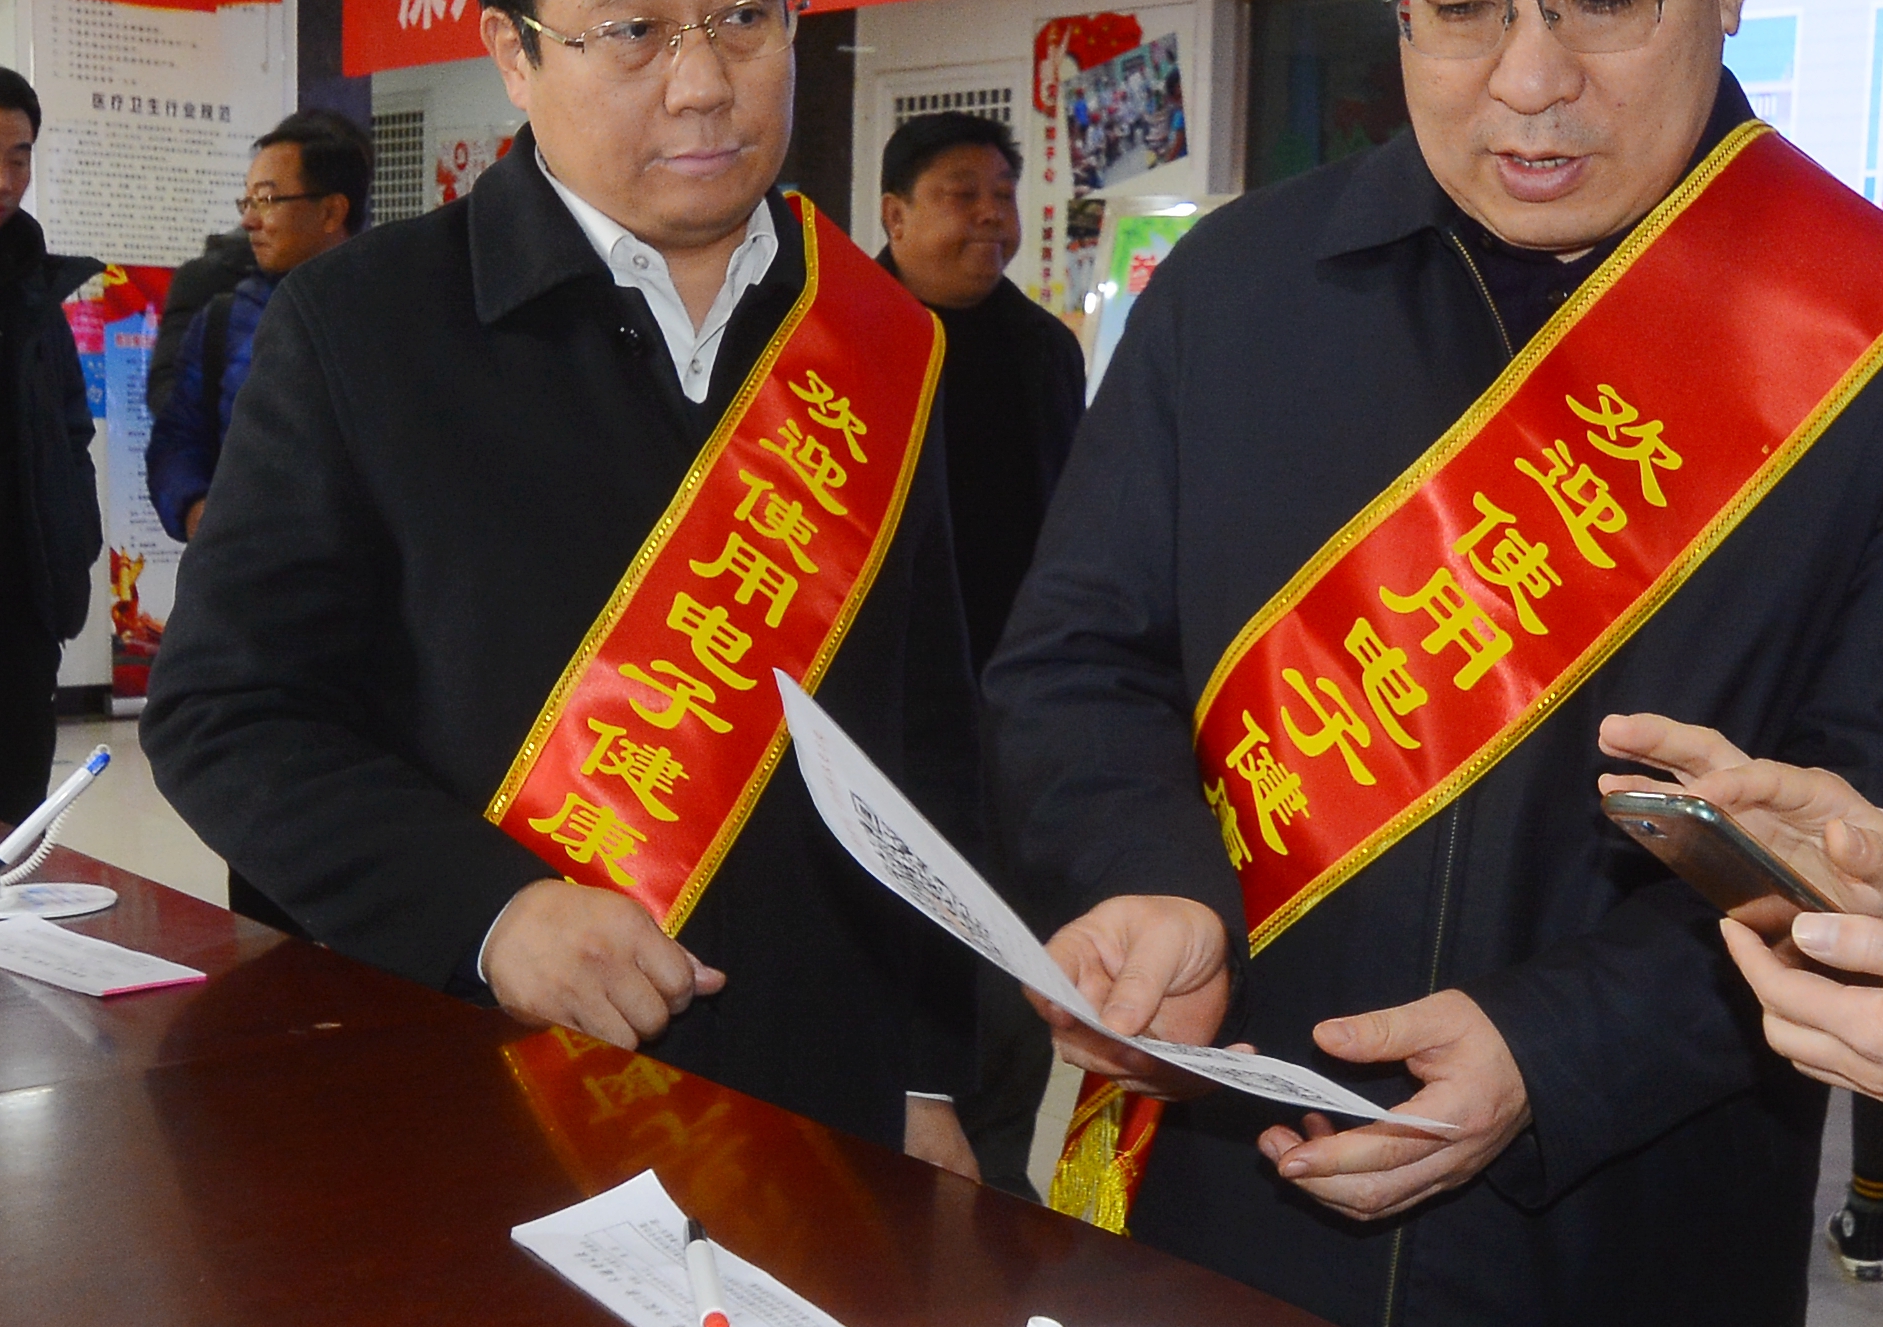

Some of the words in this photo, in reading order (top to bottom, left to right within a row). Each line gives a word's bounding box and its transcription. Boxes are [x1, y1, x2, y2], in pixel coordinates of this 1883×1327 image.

[527, 369, 868, 888] 欢迎使用电子健康
